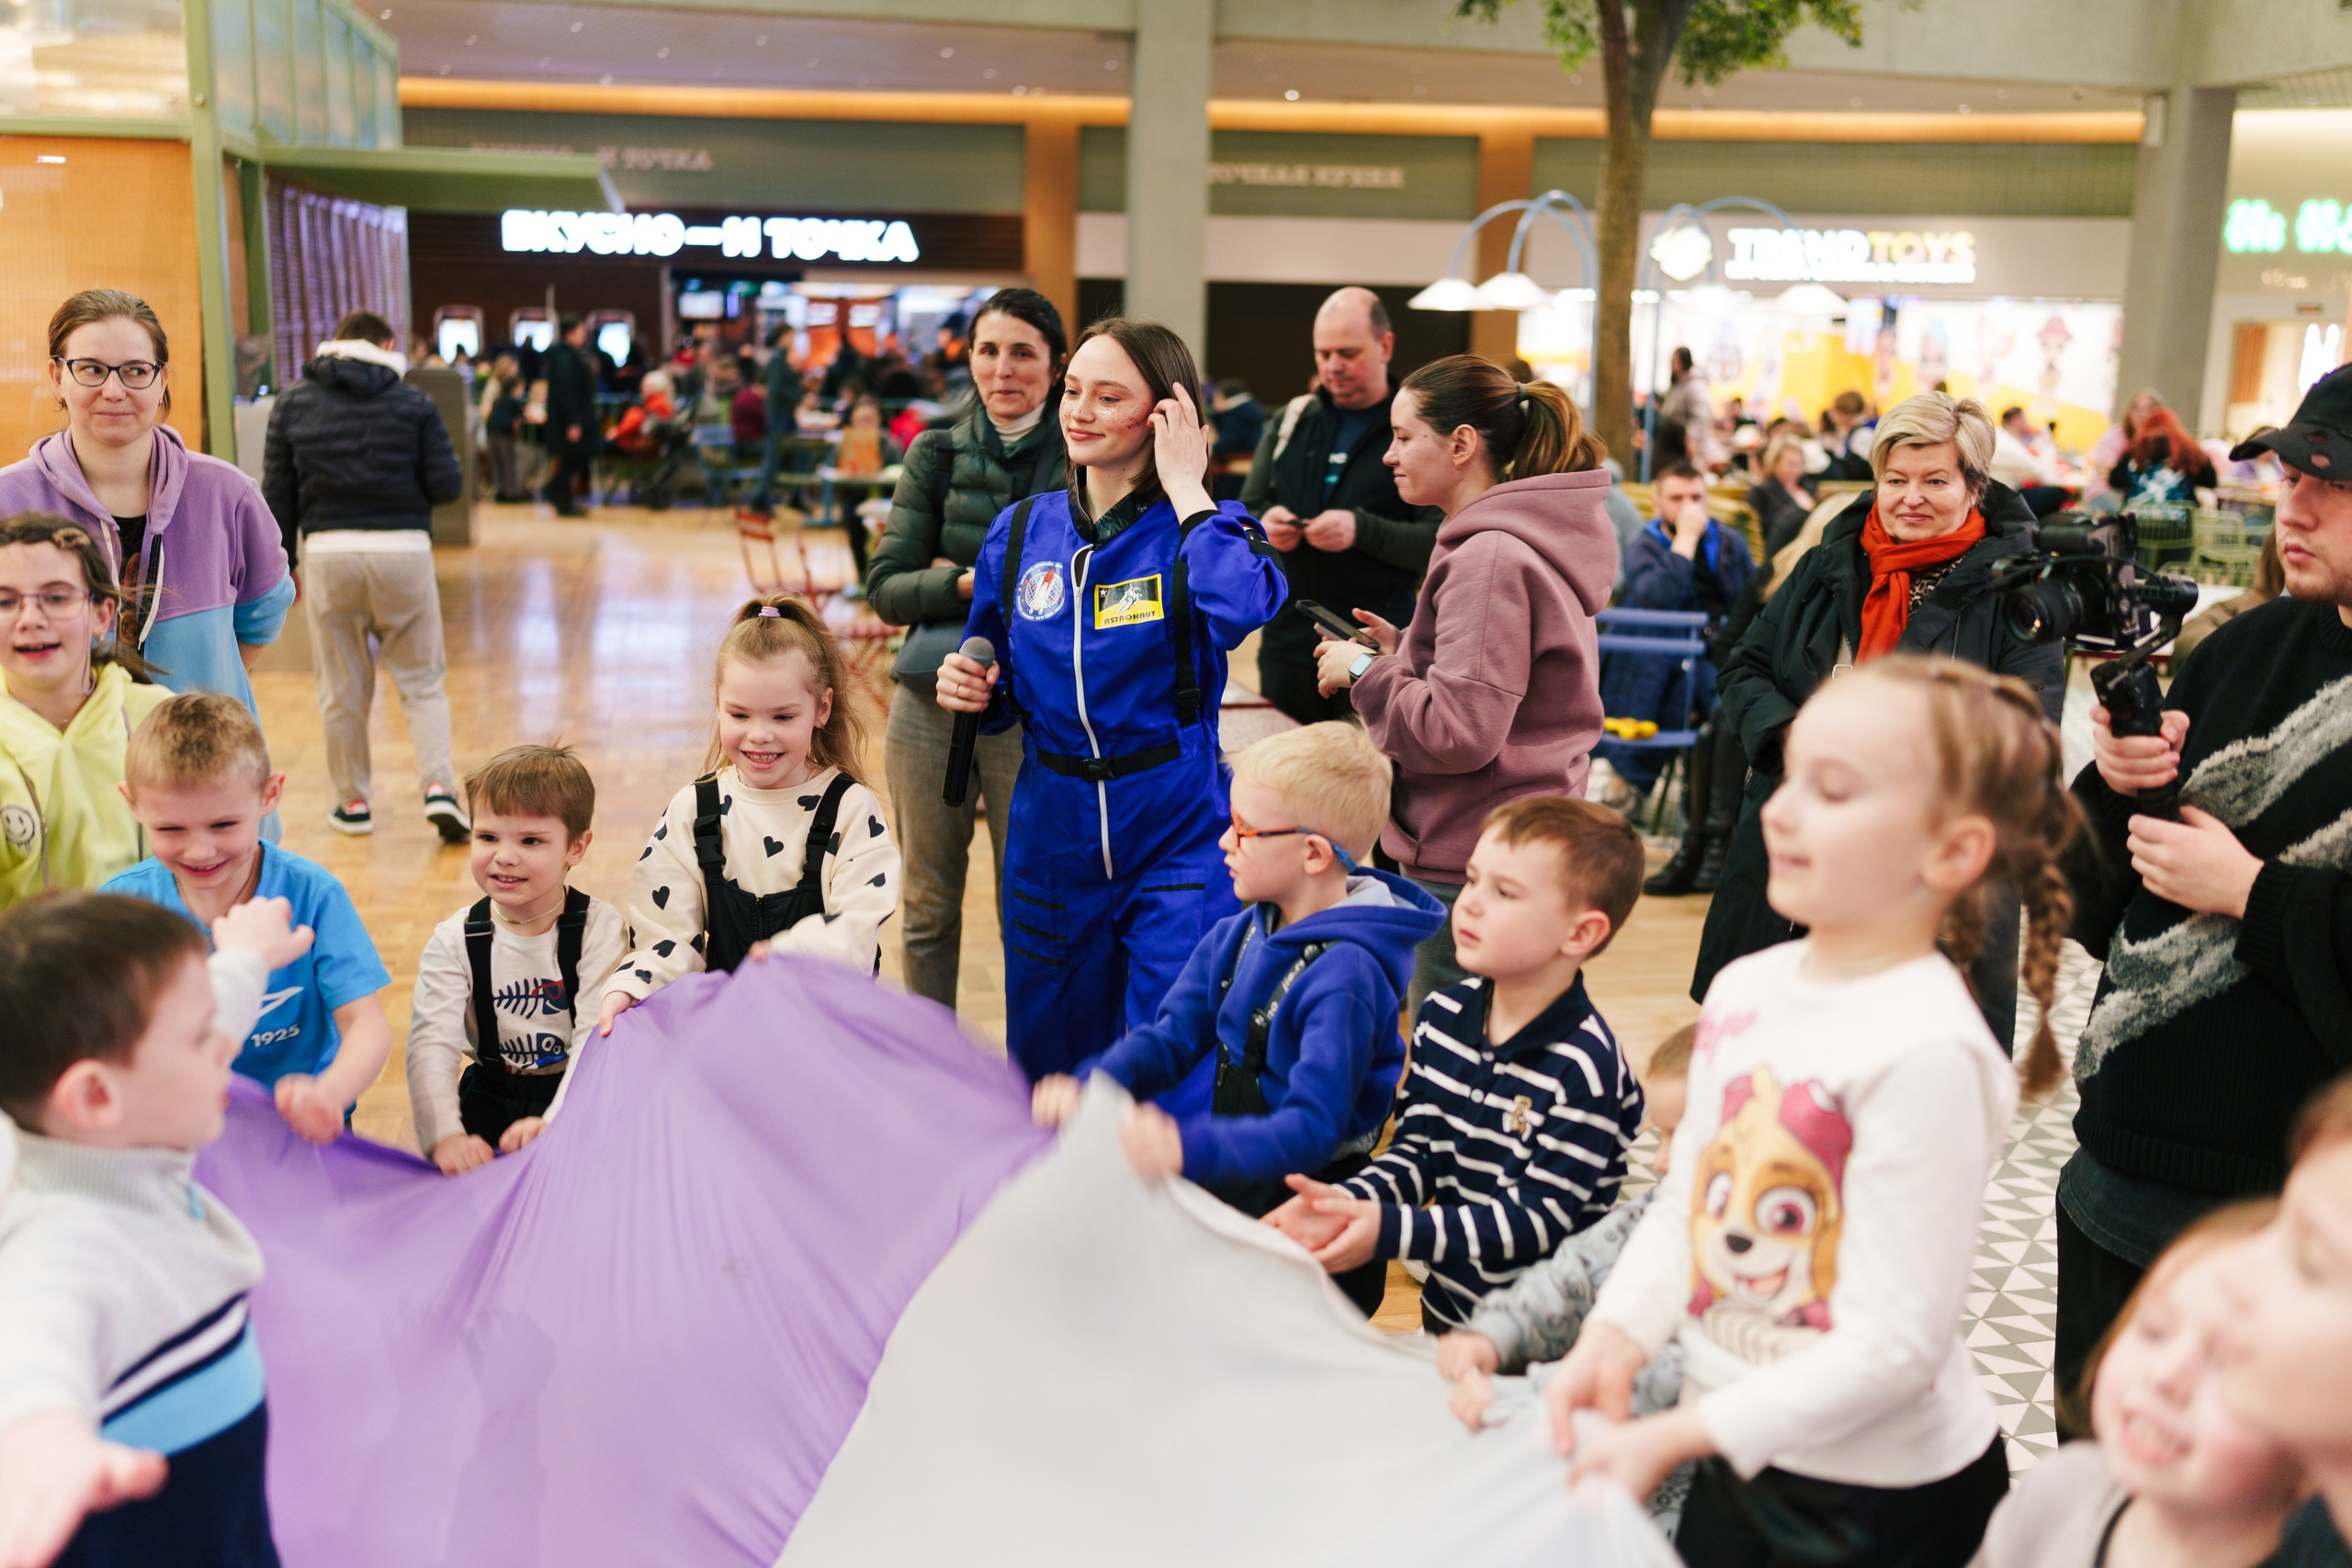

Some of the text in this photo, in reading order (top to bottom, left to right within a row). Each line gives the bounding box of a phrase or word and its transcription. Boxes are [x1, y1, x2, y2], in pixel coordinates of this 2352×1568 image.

[763, 218, 918, 262] ТОЧКА
[1103, 610, 1156, 625] ASTRONAUT
[250, 1022, 300, 1048] 1925
